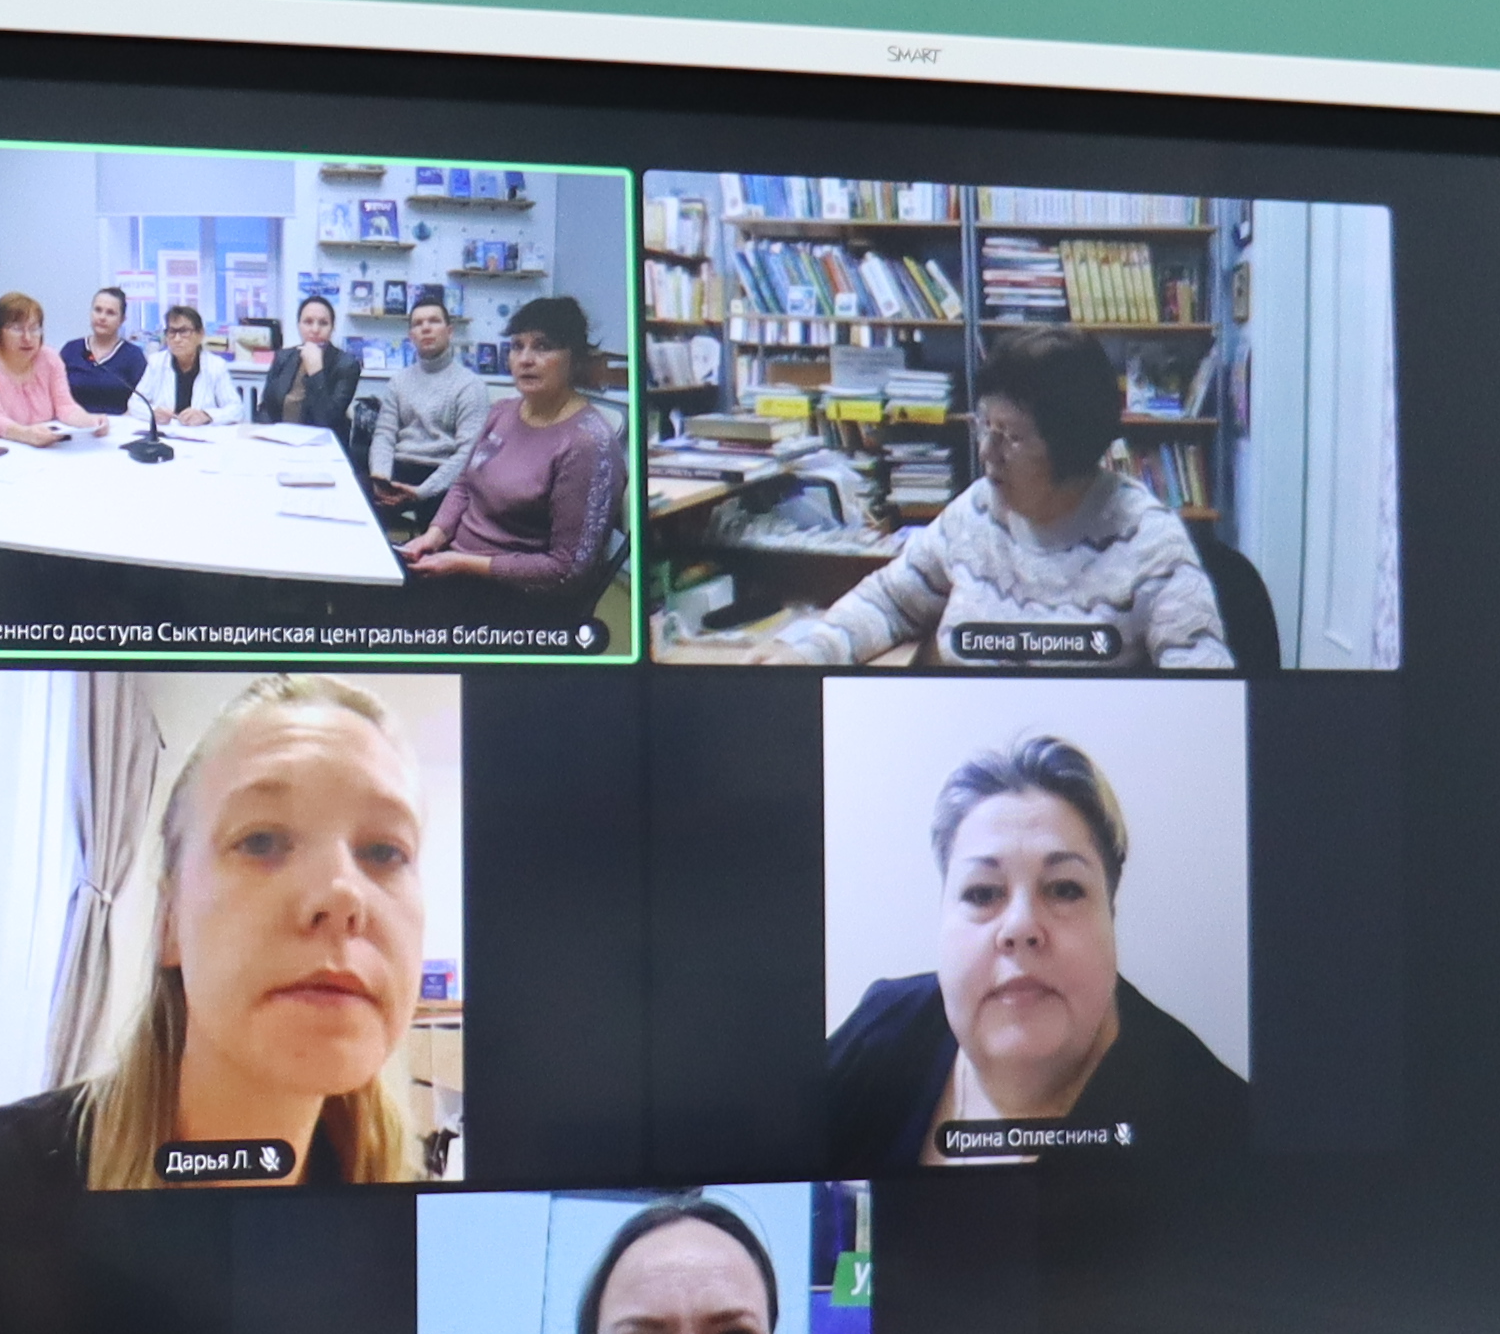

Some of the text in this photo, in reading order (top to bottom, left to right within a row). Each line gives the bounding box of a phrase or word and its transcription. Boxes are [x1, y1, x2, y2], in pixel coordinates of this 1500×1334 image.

[887, 45, 942, 64] SMART
[69, 624, 153, 646] доступа
[157, 622, 315, 644] Сыктывдинская
[320, 625, 447, 647] центральная
[452, 625, 568, 646] библиотека
[961, 631, 1084, 654] Елена Тырина
[945, 1127, 1107, 1152] Ирина Оплеснина
[165, 1149, 252, 1175] Дарья Л.
